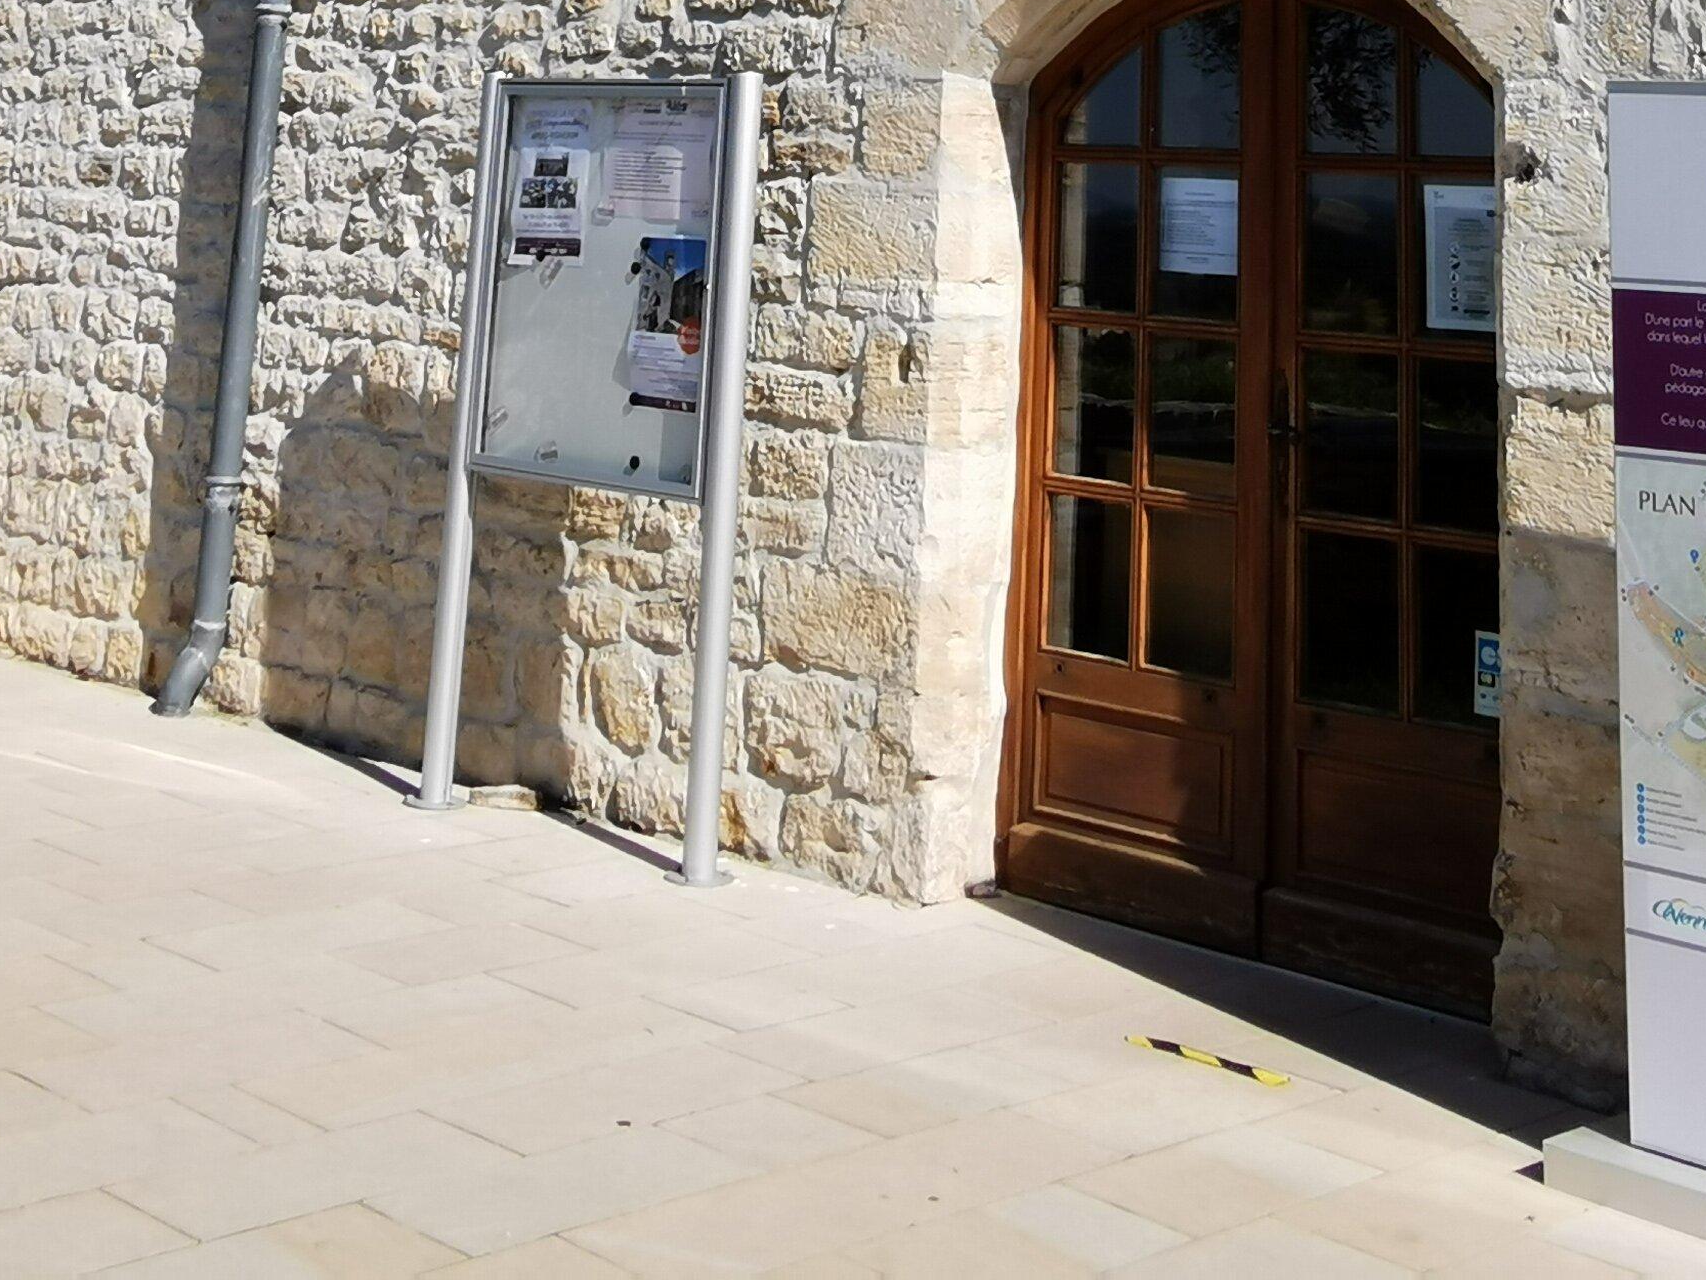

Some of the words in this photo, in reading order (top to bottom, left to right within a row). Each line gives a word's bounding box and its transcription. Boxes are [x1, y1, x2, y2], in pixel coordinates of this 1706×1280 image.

[1673, 316, 1692, 329] part
[1695, 316, 1704, 328] le
[1647, 330, 1671, 342] dans
[1672, 331, 1702, 346] lequel
[1660, 412, 1677, 426] Ce
[1678, 415, 1694, 428] lieu
[1639, 490, 1695, 516] PLAN
